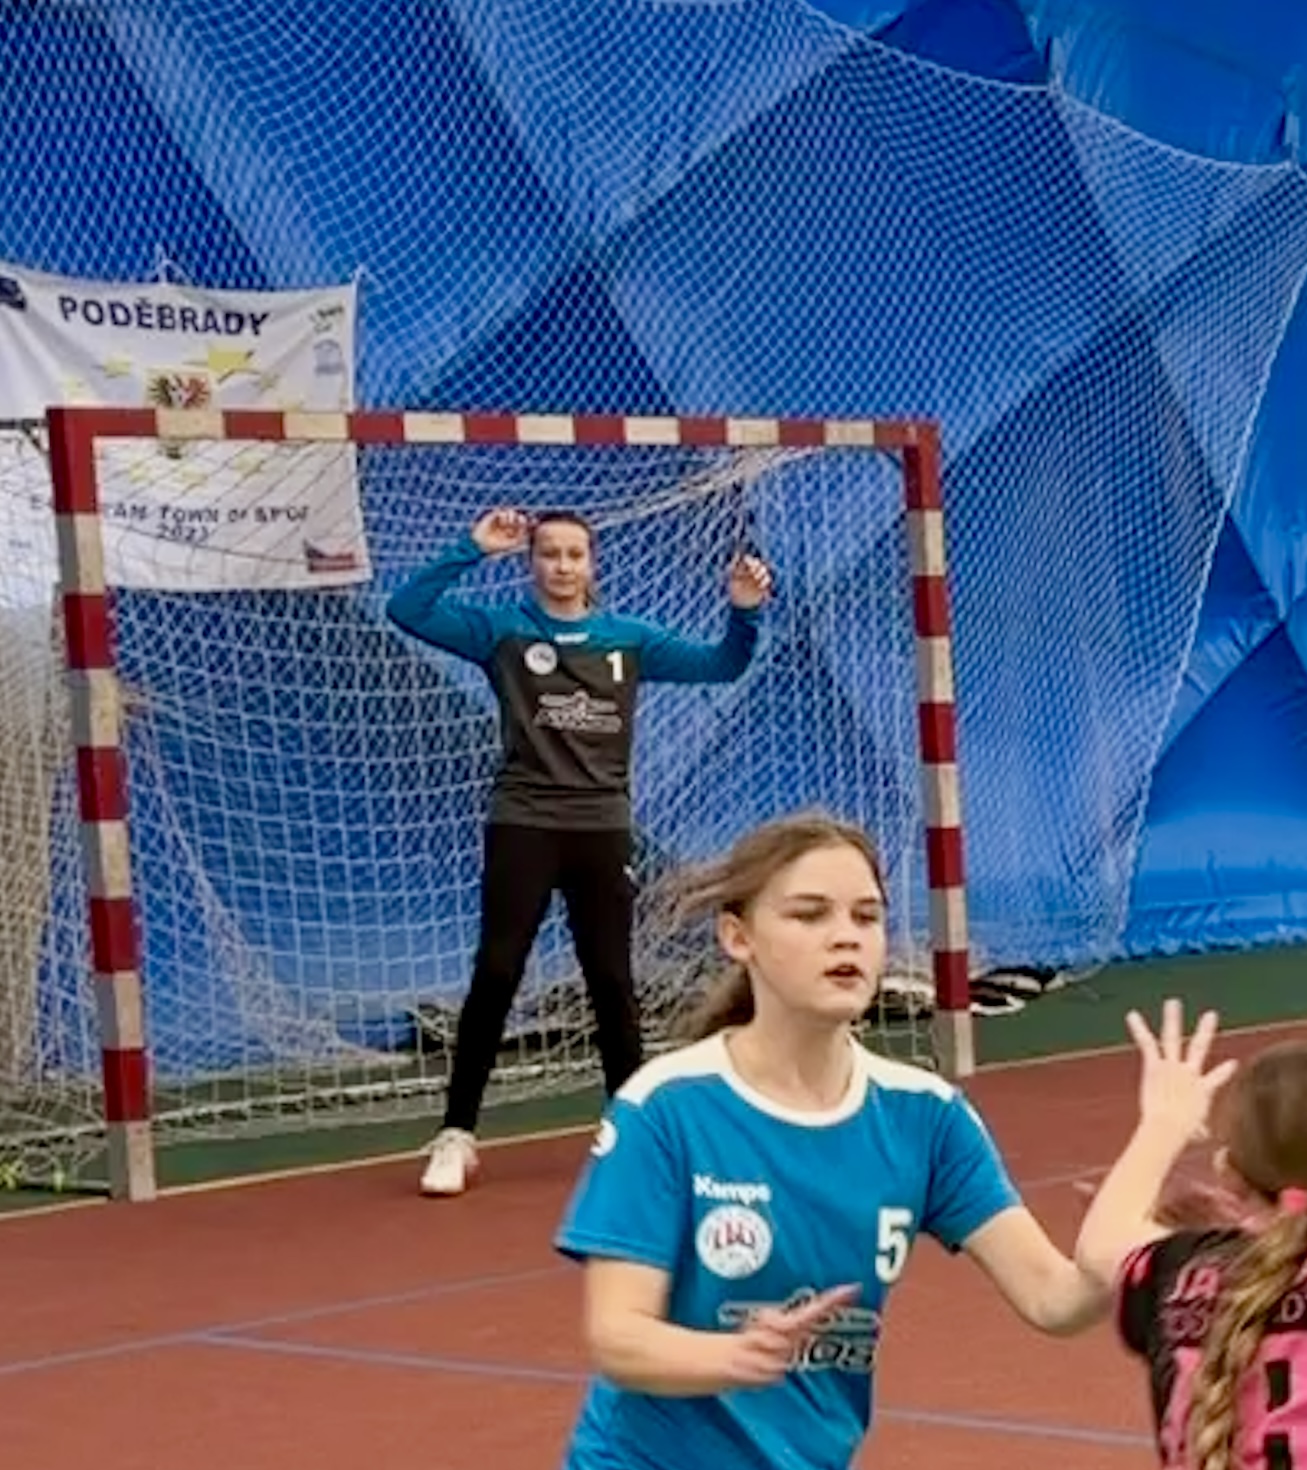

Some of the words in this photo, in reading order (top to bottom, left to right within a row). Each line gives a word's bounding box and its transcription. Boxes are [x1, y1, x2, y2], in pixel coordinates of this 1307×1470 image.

[58, 296, 270, 336] PODĚBRADY
[159, 504, 219, 523] TOWN
[606, 650, 623, 682] 1
[875, 1208, 914, 1283] 5
